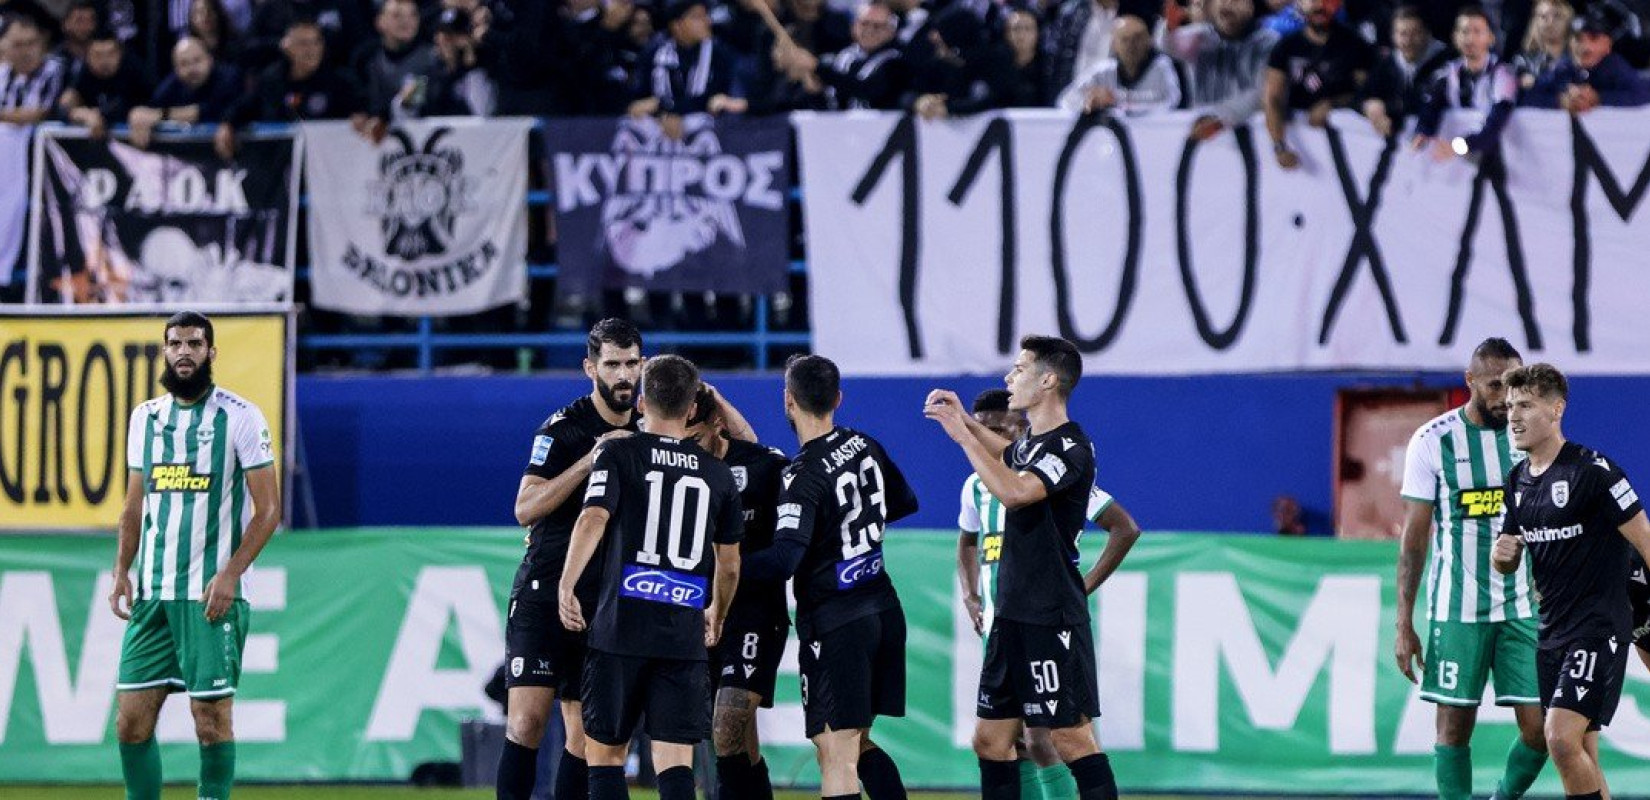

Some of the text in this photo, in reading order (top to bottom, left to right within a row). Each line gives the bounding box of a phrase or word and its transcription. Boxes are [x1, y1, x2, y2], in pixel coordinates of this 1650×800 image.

[154, 466, 190, 479] PARI
[652, 448, 699, 470] MURG
[822, 458, 836, 474] J.
[157, 477, 211, 490] MATCH
[636, 470, 710, 571] 10
[836, 455, 887, 560] 23
[742, 632, 759, 659] 8
[1030, 659, 1060, 694] 50
[1438, 660, 1459, 690] 13
[1569, 650, 1598, 682] 31
